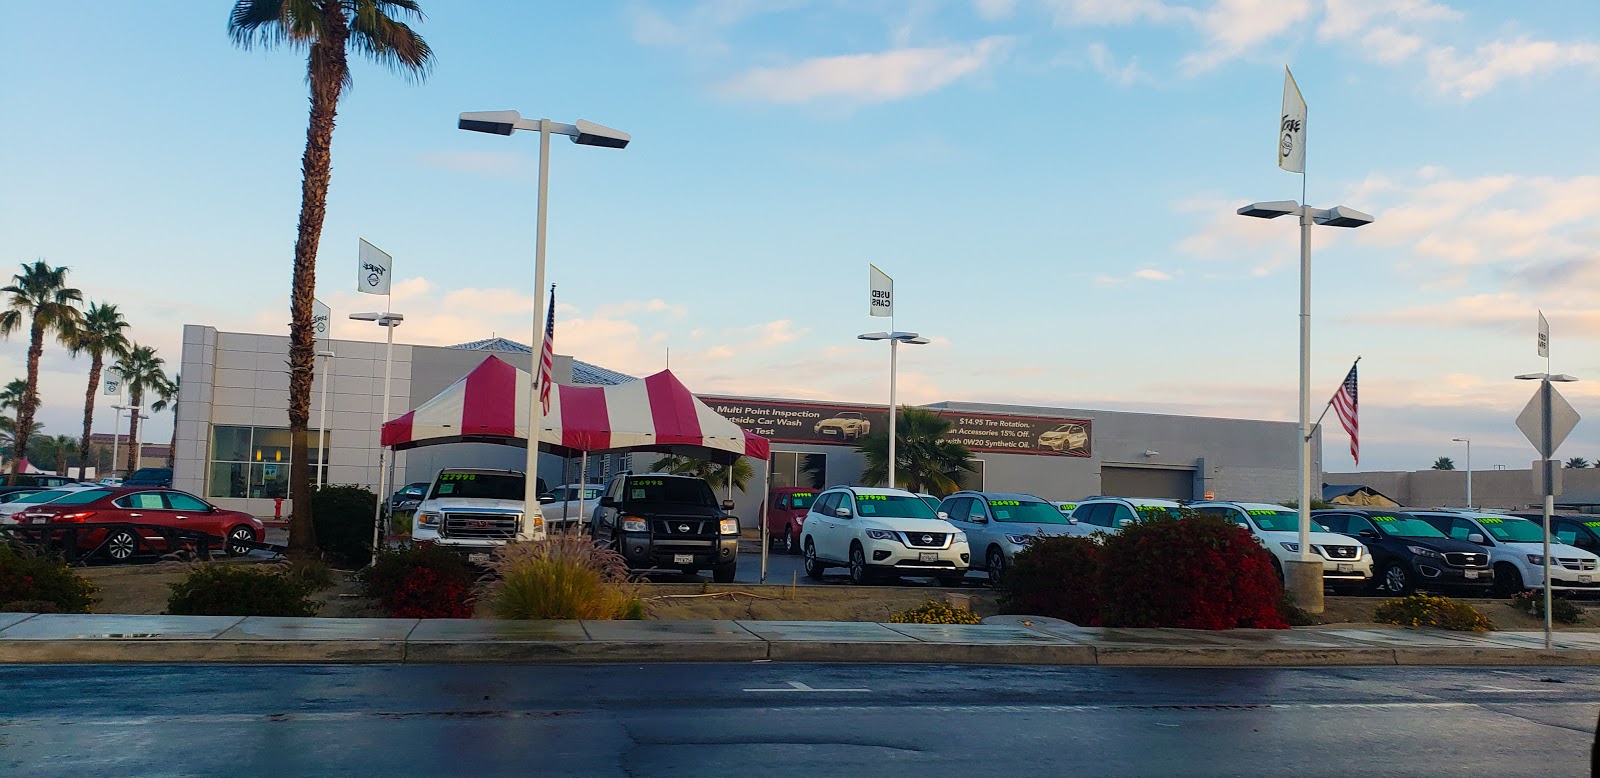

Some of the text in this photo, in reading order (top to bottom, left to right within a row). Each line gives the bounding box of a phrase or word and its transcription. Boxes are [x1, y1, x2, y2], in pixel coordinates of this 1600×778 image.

[717, 405, 742, 414] Multi
[745, 407, 770, 415] Point
[772, 409, 820, 418] Inspection
[777, 418, 802, 427] Wash
[959, 418, 983, 426] $14.95
[985, 419, 998, 427] Tire
[958, 428, 999, 437] Accessories
[985, 440, 1017, 448] Synthetic
